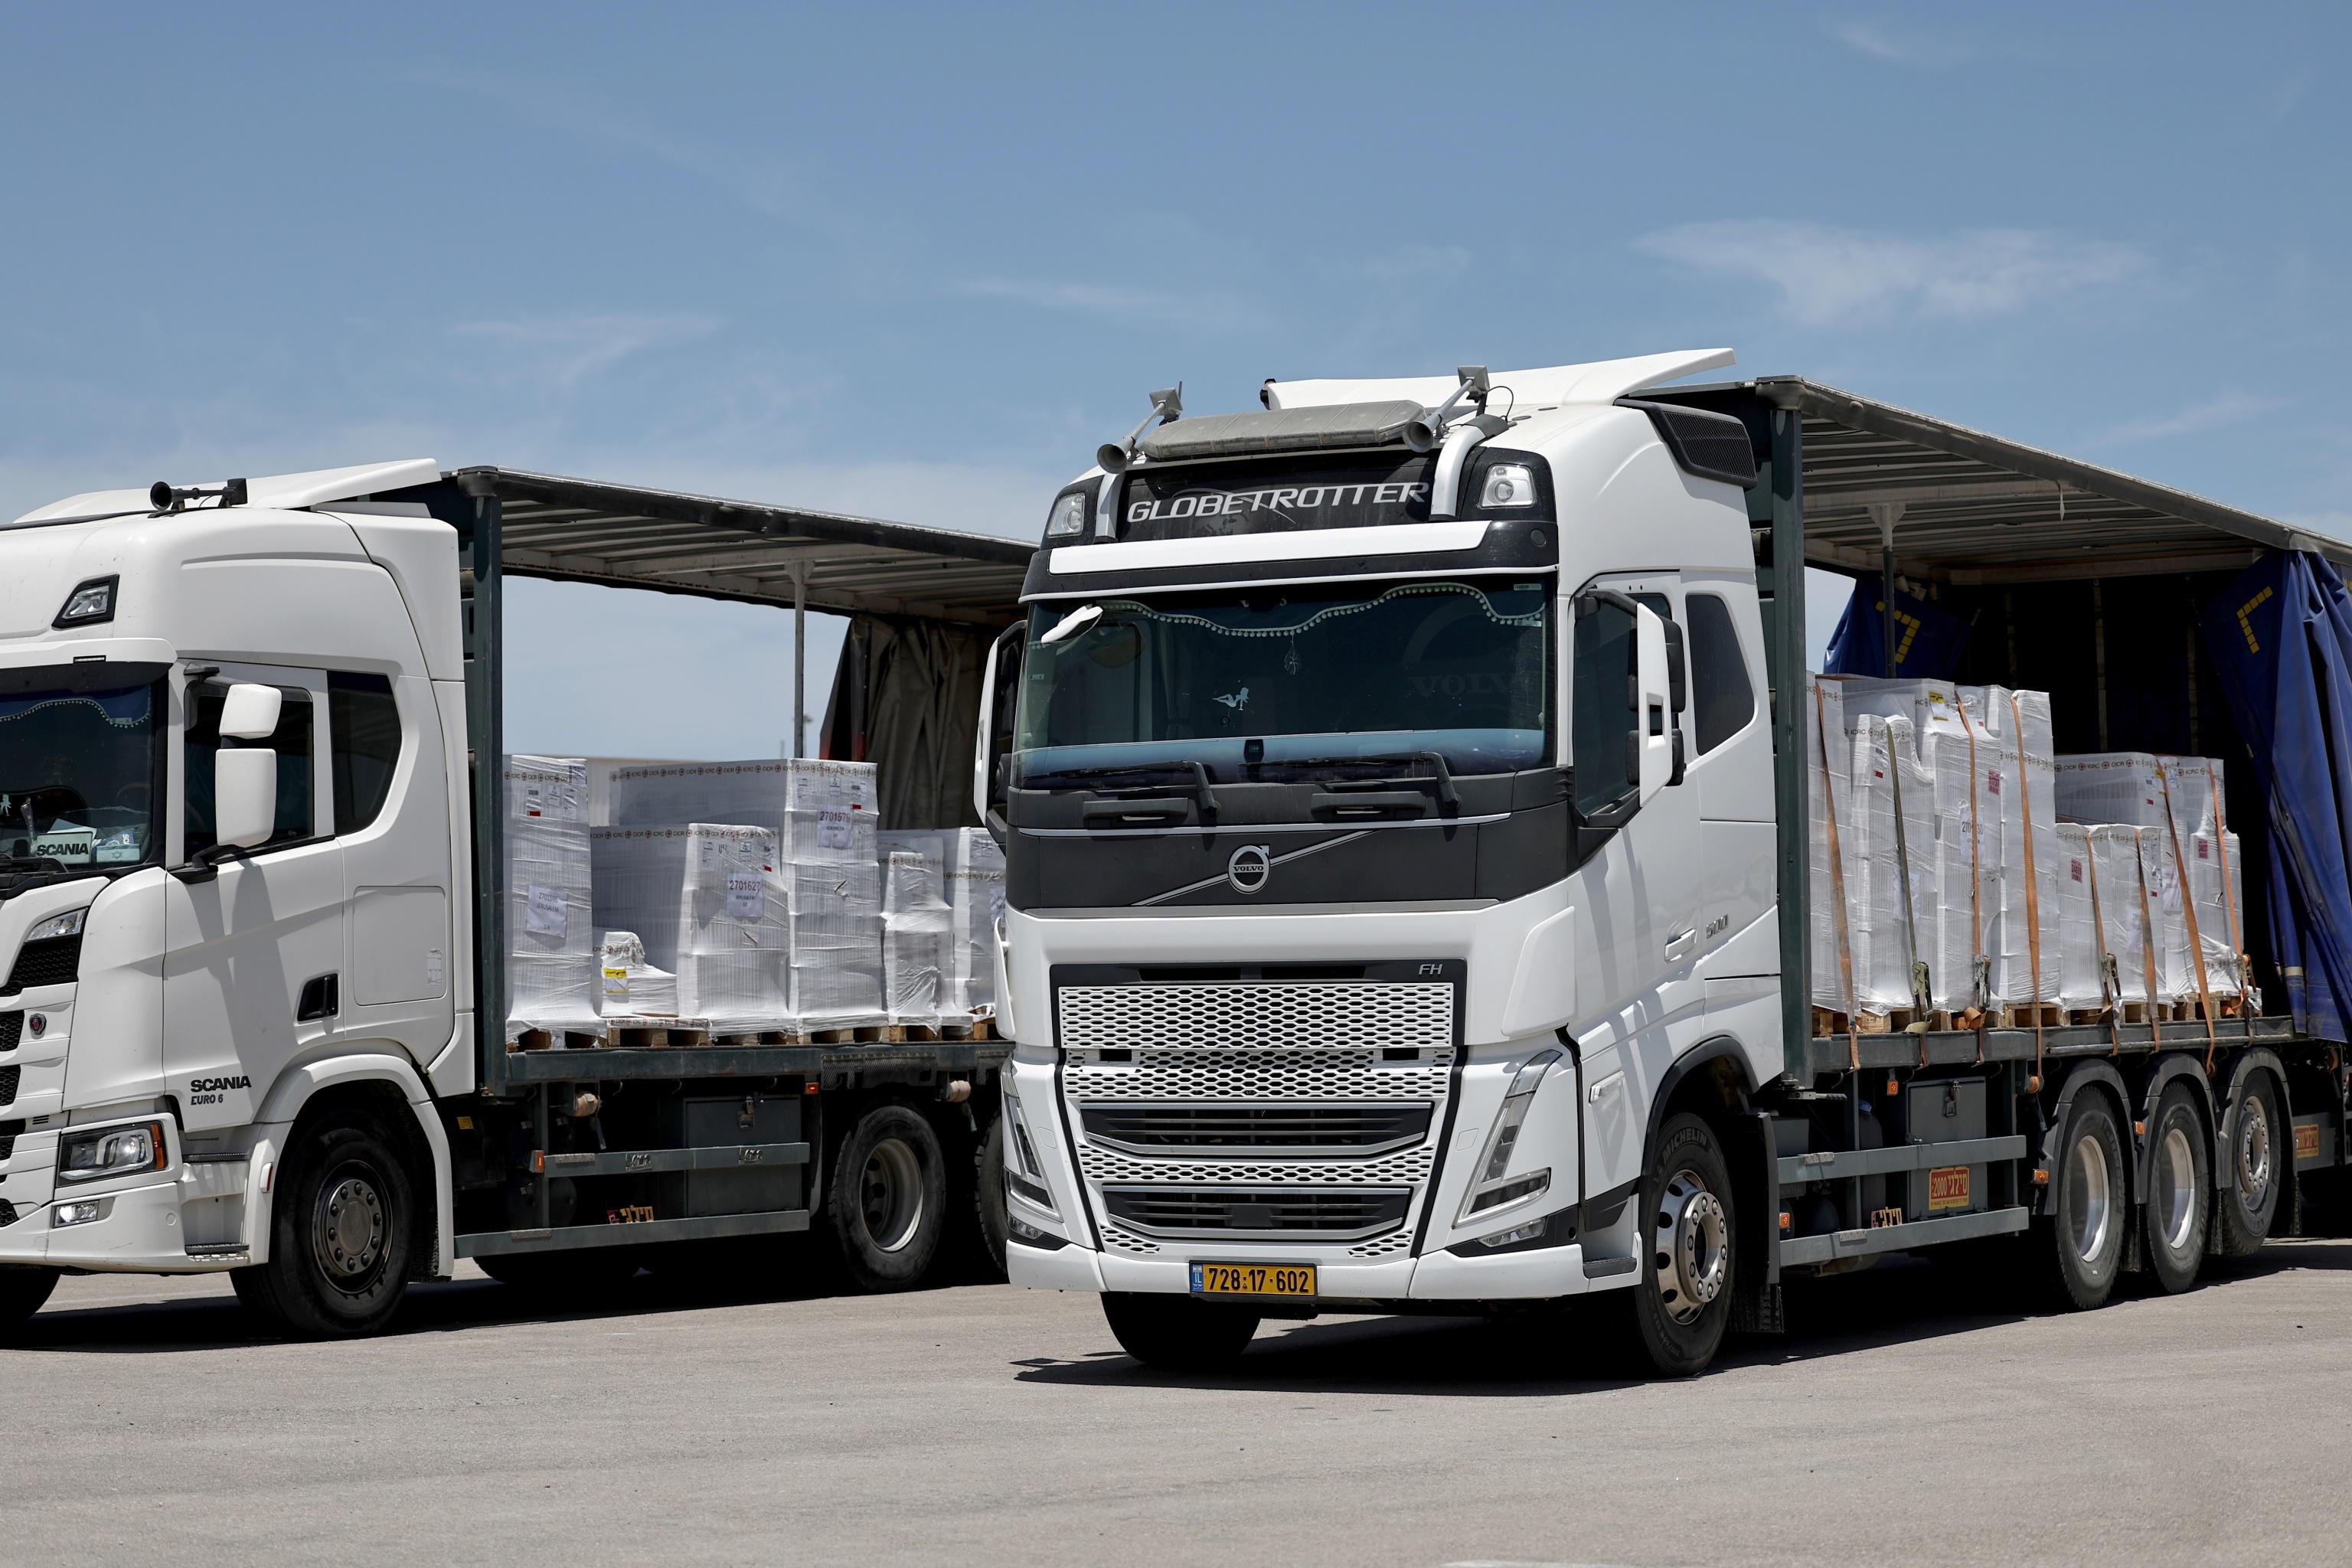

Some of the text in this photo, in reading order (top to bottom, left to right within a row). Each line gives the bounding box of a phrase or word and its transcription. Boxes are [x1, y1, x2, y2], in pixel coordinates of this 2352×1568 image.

[1127, 482, 1429, 523] GLOBETROTTER
[820, 811, 851, 823] 2701579
[37, 843, 89, 857] SCANIA
[729, 880, 761, 892] 2701627
[1706, 914, 1728, 939] 500
[1418, 963, 1443, 975] FH
[191, 1076, 252, 1093] SCANIA
[191, 1093, 224, 1106] EURO 6
[1662, 1127, 1708, 1166] MICHELIN
[1933, 1177, 1948, 1197] 2000
[1194, 1272, 1202, 1283] IL
